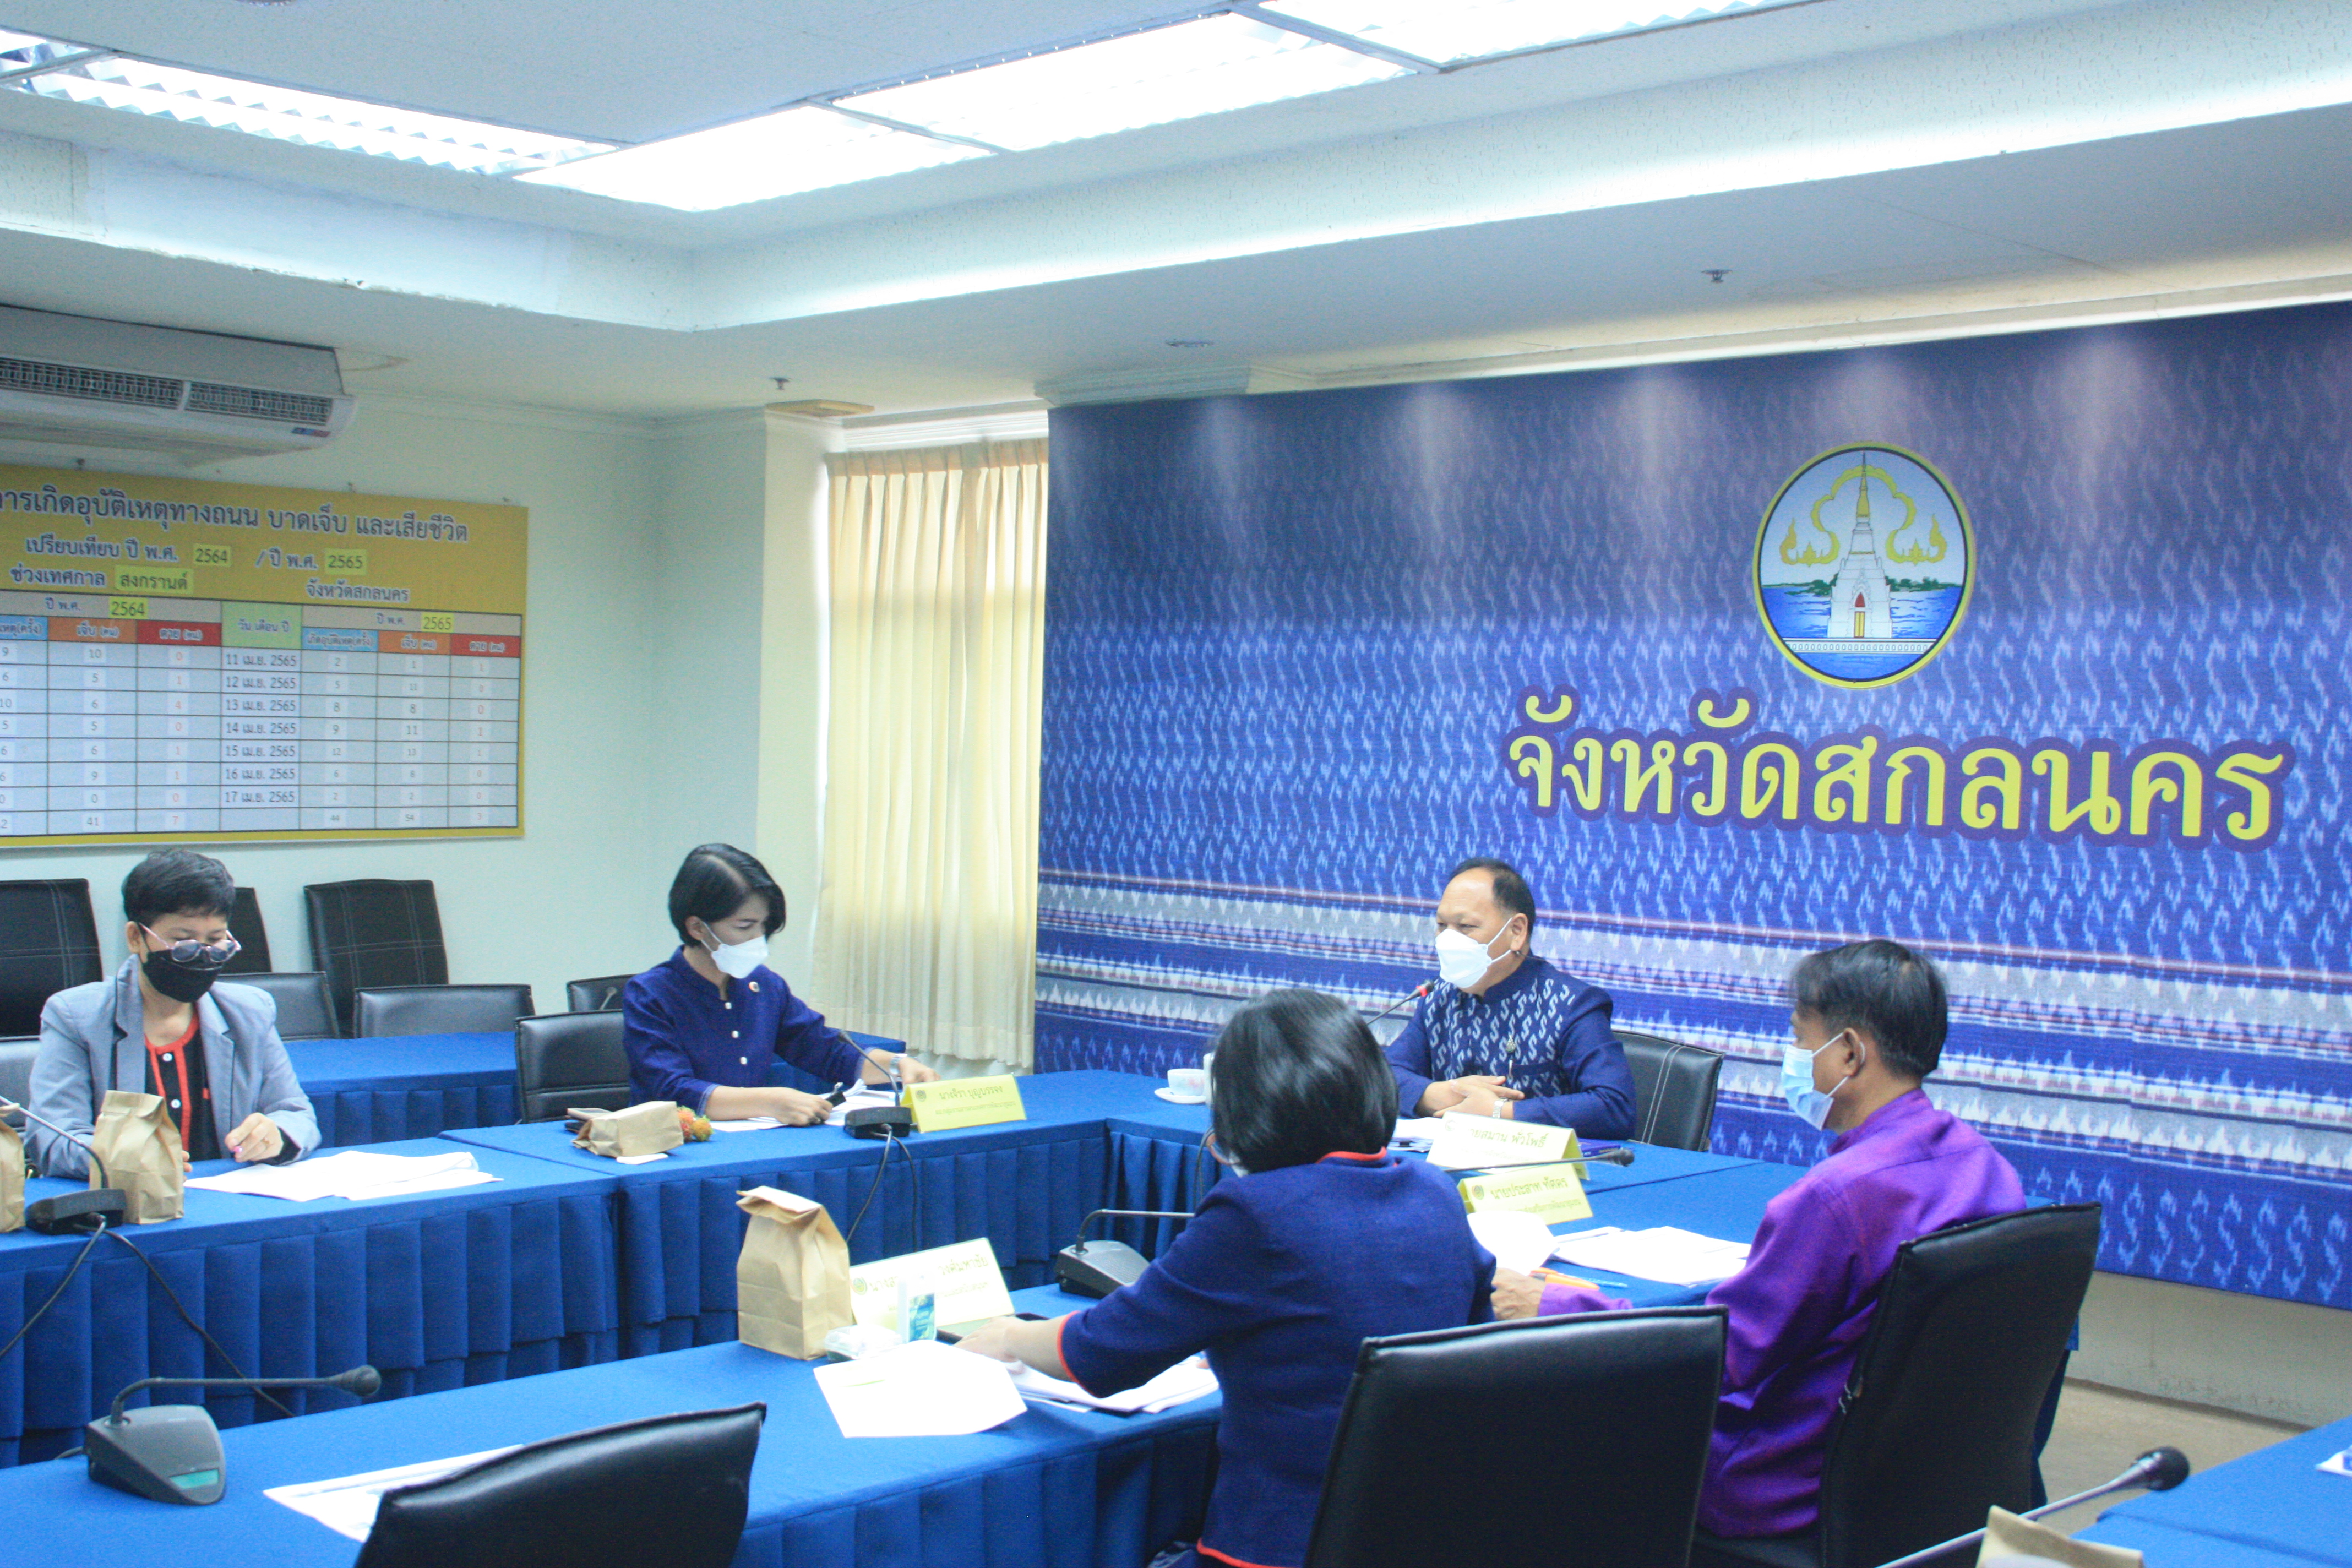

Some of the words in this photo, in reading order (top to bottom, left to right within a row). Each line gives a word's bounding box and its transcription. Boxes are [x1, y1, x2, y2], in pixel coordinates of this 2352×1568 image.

[268, 503, 347, 533] บาดเจ็บ
[356, 511, 468, 542] และเสียชีวิต
[26, 532, 120, 558] เปรียบเทียบ
[124, 537, 139, 560] ปี
[144, 545, 179, 562] พ.ศ.
[194, 548, 228, 563] 2564
[286, 554, 318, 570] พ.ศ.
[328, 554, 363, 569] 2565
[10, 562, 106, 587] ช่วงเทศกาล
[119, 571, 188, 590] สงกรานต์
[307, 578, 410, 602] จังหวัดสกลนคร
[111, 601, 145, 616] 2564
[423, 616, 451, 630] 2565
[3, 647, 8, 657] 9
[89, 649, 101, 659] 10
[176, 651, 182, 661] 0
[226, 654, 239, 665] 11
[243, 655, 266, 666] เม.ย.
[270, 655, 296, 666] 2565
[3, 672, 9, 682] 6
[92, 673, 99, 683] 5
[176, 676, 182, 684] 1
[226, 676, 238, 688] 12
[242, 678, 266, 688] เม.ย.
[270, 677, 296, 689] 2565
[0, 698, 12, 708] 10
[91, 699, 99, 709] 6
[175, 700, 182, 709] 4
[225, 699, 238, 710] 13
[242, 701, 265, 711] เม.ย.
[270, 700, 296, 711] 2565
[2, 720, 8, 730] 5
[91, 721, 98, 731] 5
[175, 722, 182, 731] 0
[226, 722, 239, 733] 14
[243, 724, 266, 734] เม.ย.
[270, 723, 296, 734] 2565
[1, 745, 8, 755] 6
[91, 745, 98, 755] 6
[176, 746, 181, 755] 1
[225, 745, 238, 756] 15
[242, 747, 265, 756] เม.ย.
[270, 745, 295, 756] 2565
[1509, 695, 2284, 841] จังหวัดสกลนคร
[91, 771, 98, 781] 9
[175, 771, 180, 779] 1
[225, 768, 238, 779] 16
[242, 770, 265, 779] เม.ย.
[269, 768, 295, 779] 2565
[91, 794, 99, 803] 0
[172, 793, 179, 802] 0
[225, 791, 237, 802] 17
[242, 793, 265, 803] เม.ย.
[269, 791, 295, 802] 2565
[86, 817, 100, 826] 41
[172, 816, 179, 825] 7
[1468, 1128, 1508, 1142] ายสมาน
